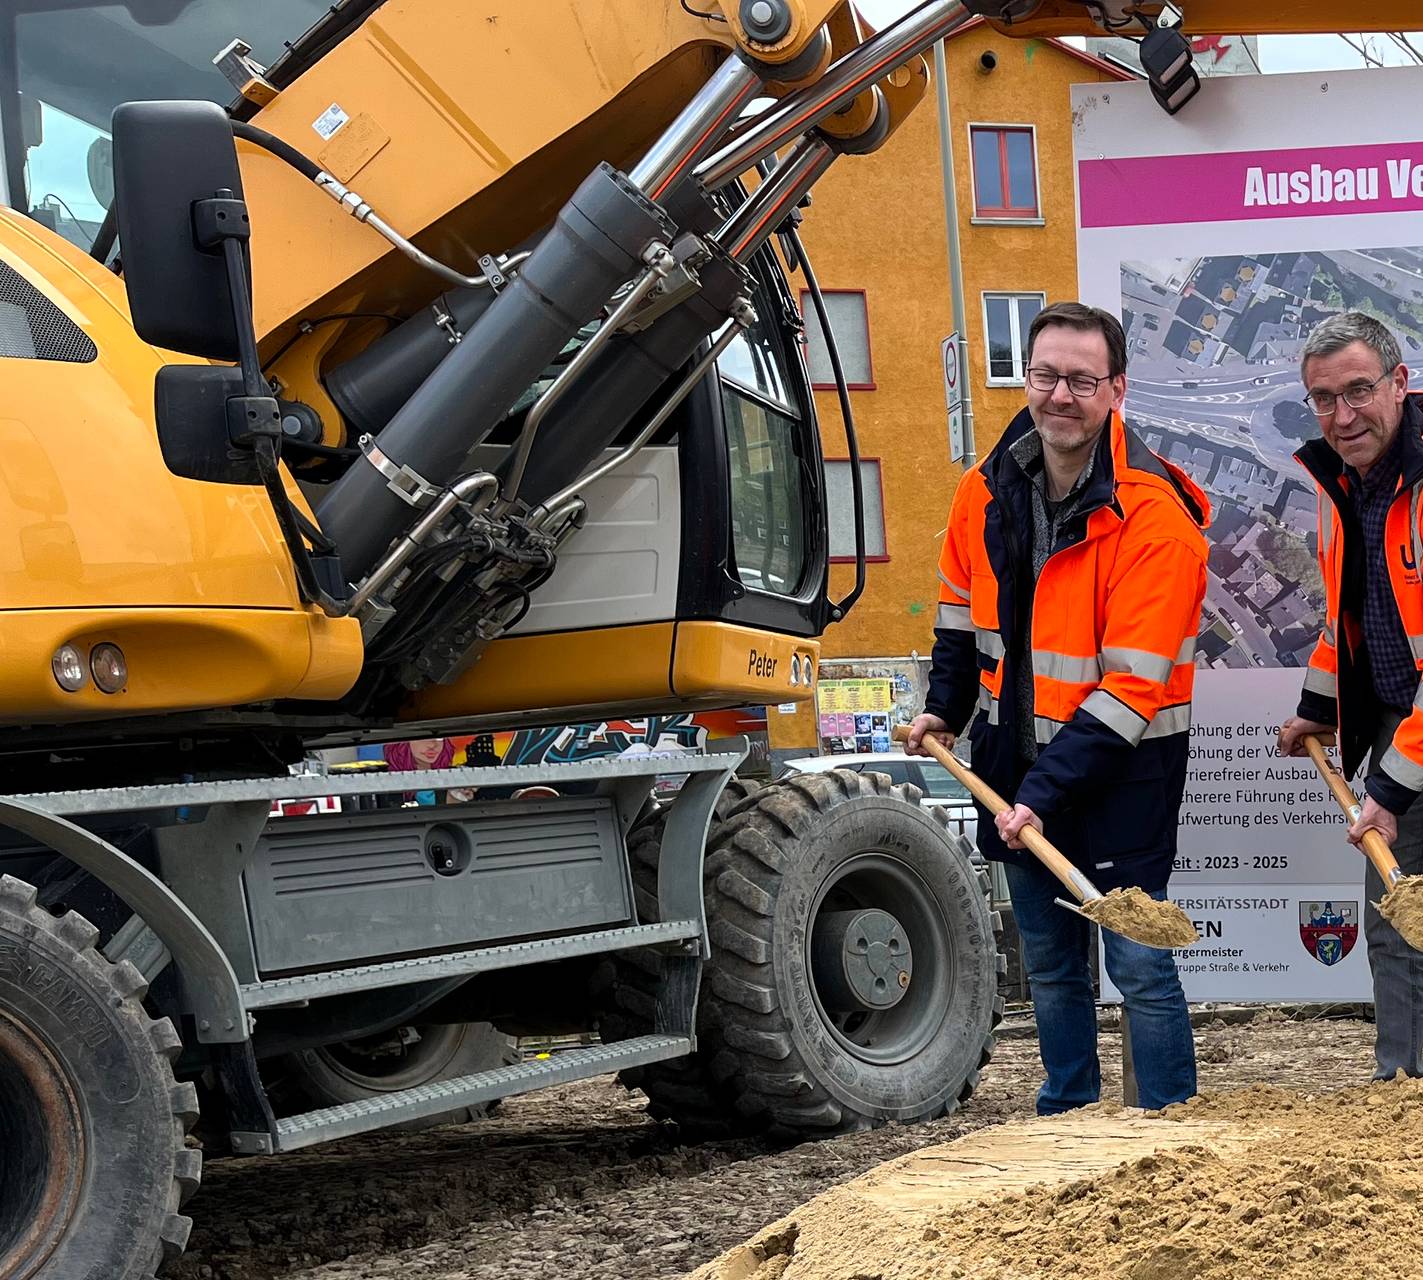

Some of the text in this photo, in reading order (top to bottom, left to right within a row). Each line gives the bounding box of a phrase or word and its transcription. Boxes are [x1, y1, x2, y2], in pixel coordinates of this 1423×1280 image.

[1243, 164, 1379, 206] Ausbau
[748, 649, 777, 678] Peter
[1188, 723, 1232, 740] öhung
[1236, 723, 1260, 737] der
[1188, 745, 1233, 762] öhung
[1237, 745, 1260, 759] der
[1186, 767, 1260, 781] rierefreier
[1265, 767, 1318, 780] Ausbau
[1182, 790, 1231, 803] herere
[1236, 789, 1294, 806] Führung
[1299, 789, 1323, 802] des
[1178, 811, 1348, 828] ufwertung des Verkehrs
[1204, 856, 1239, 869] 2023
[1252, 856, 1288, 869] 2025
[1173, 896, 1289, 909] ERSITÄTSSTADT
[1209, 963, 1240, 972] Straße
[1243, 963, 1250, 972] &
[1253, 962, 1290, 972] Verkehr
